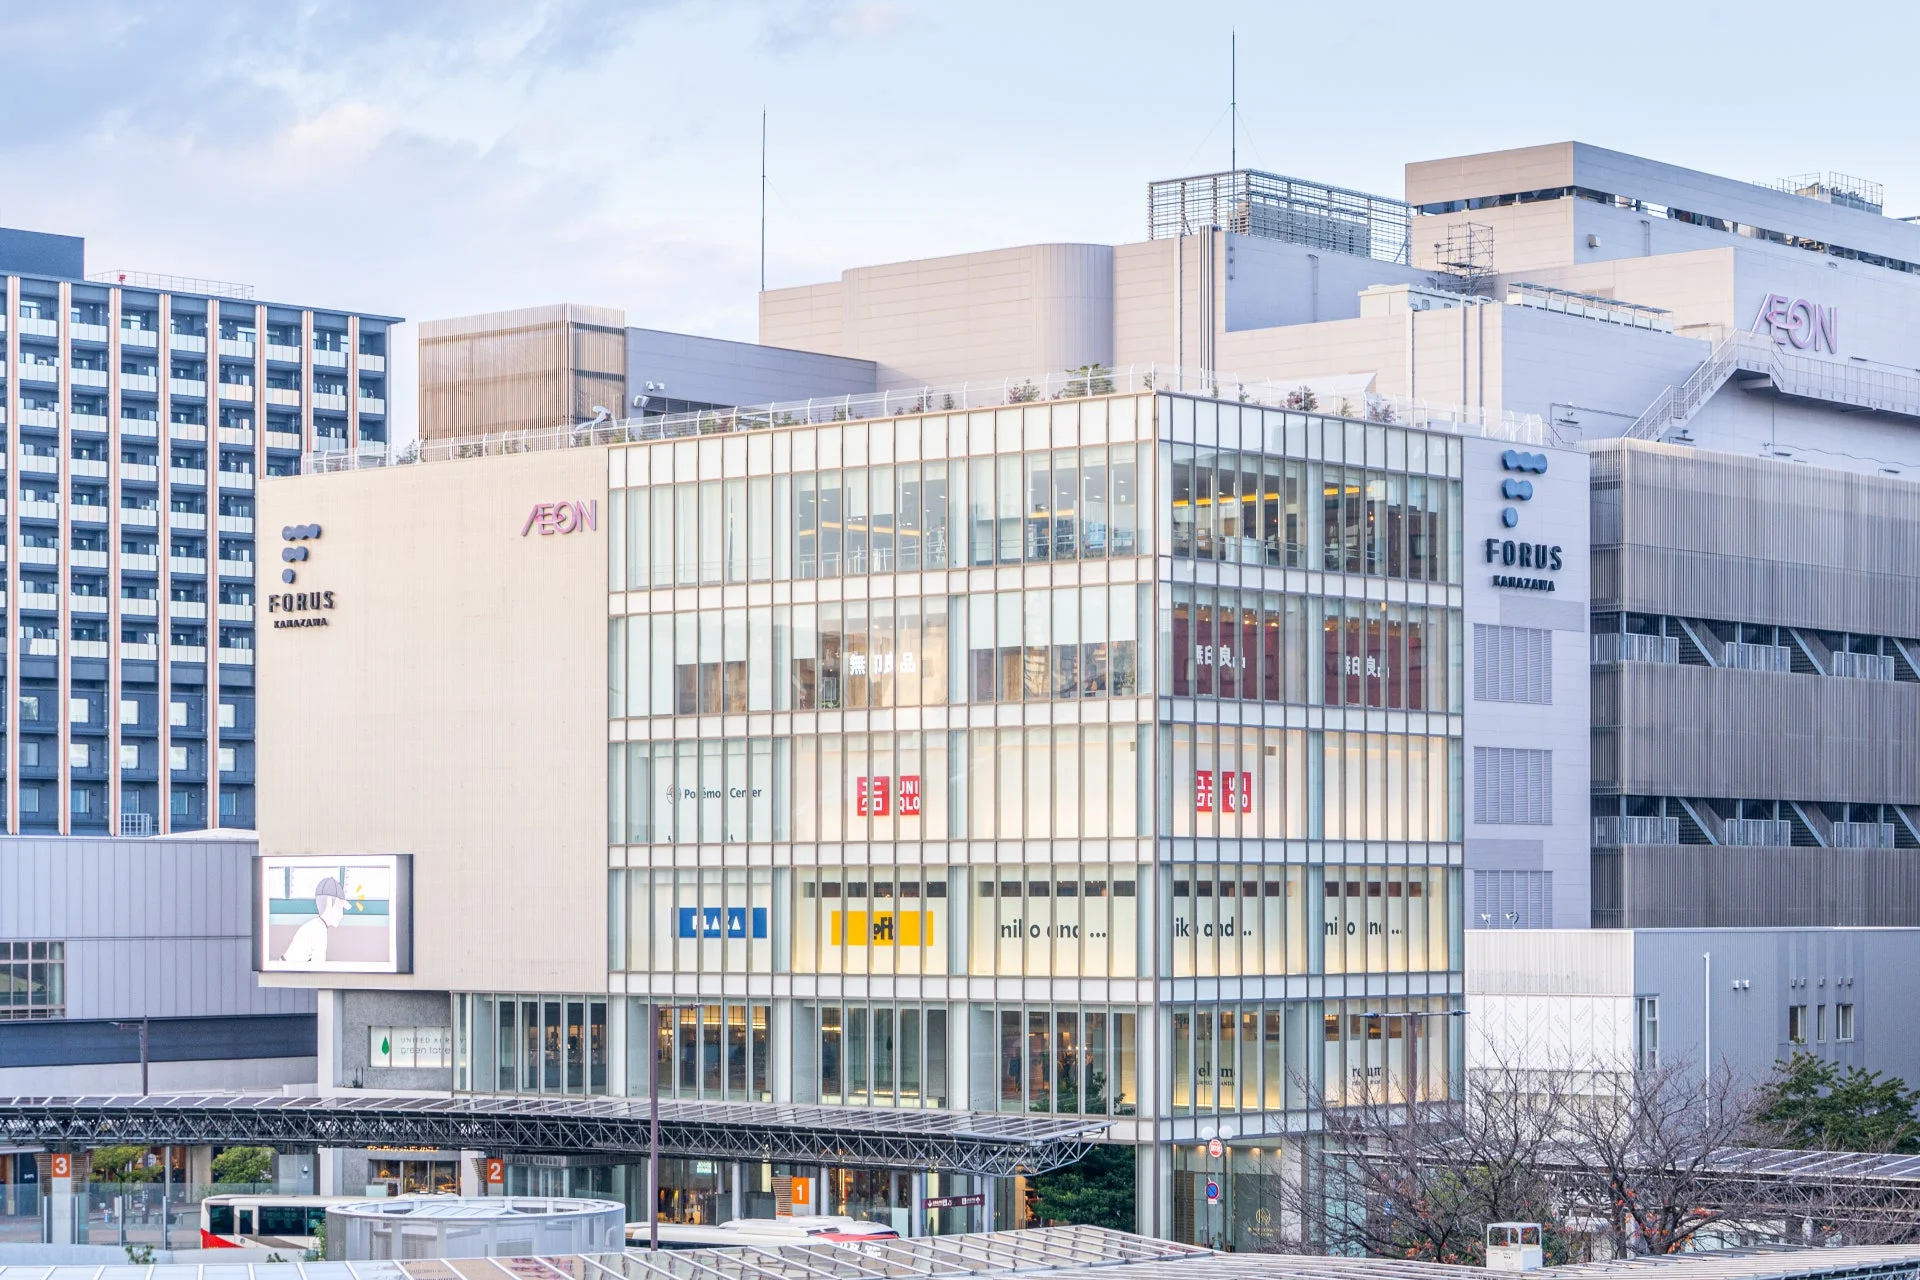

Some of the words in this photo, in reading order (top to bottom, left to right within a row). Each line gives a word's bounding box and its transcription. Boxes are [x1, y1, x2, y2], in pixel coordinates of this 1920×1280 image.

[1486, 538, 1562, 571] FORUS
[1492, 575, 1556, 592] KANAZAWA
[268, 590, 335, 613] FORUS
[273, 617, 328, 629] KANAZAWA
[684, 786, 722, 799] Poémo
[729, 787, 762, 798] Cener
[1228, 776, 1247, 792] UI
[1228, 793, 1248, 810] QO
[1324, 916, 1356, 935] nio
[55, 1157, 67, 1175] 3
[490, 1162, 501, 1180] 2
[796, 1184, 803, 1201] 1
